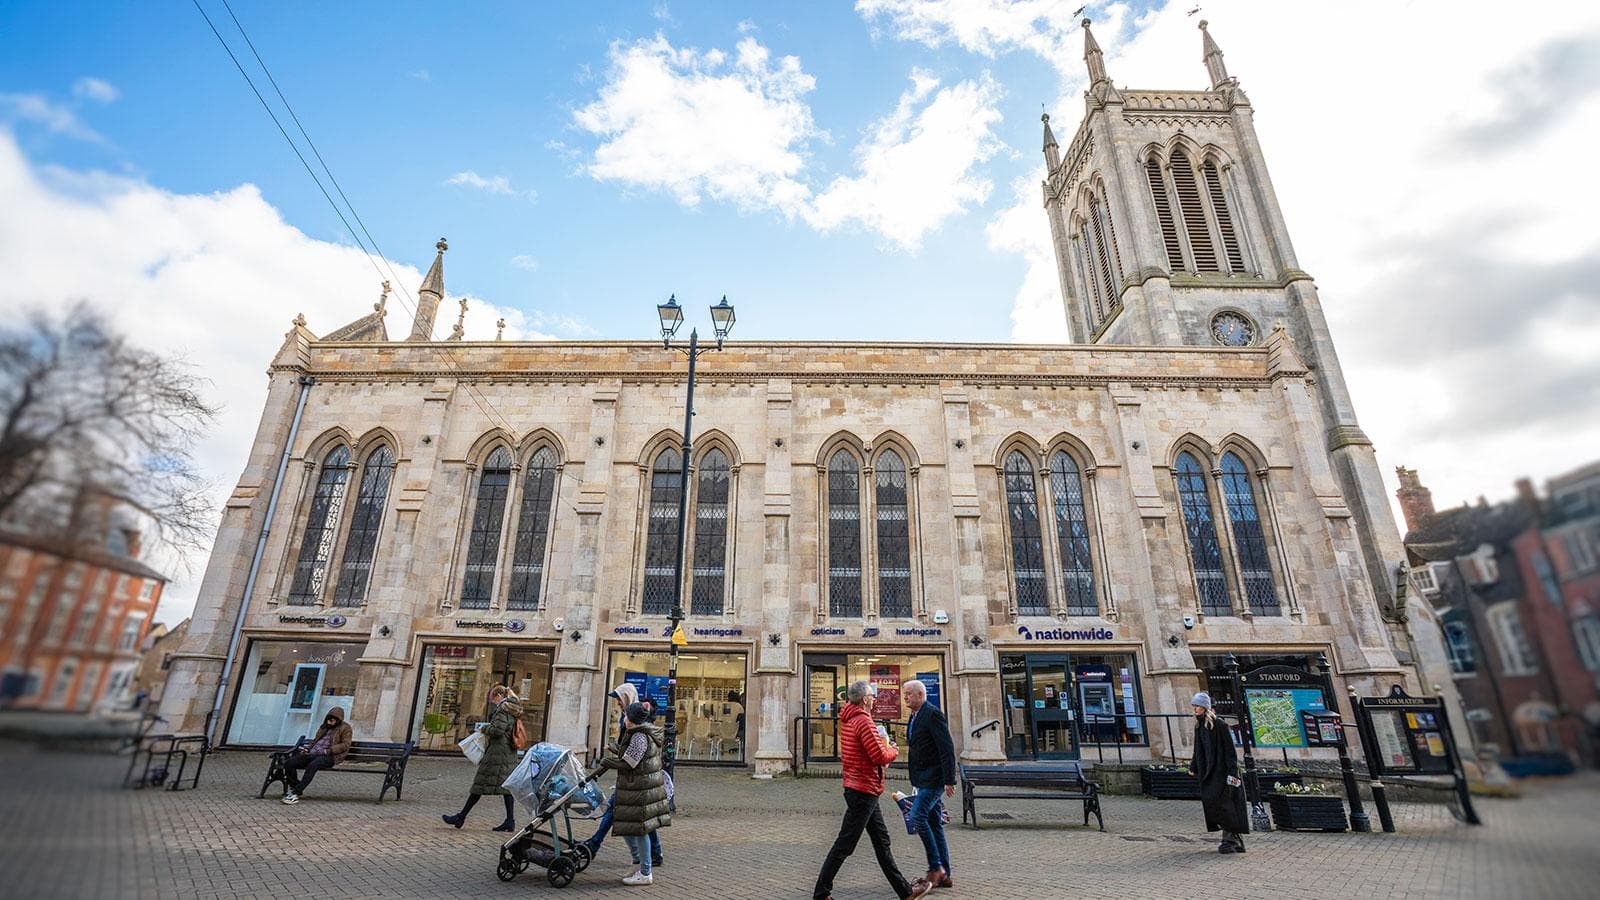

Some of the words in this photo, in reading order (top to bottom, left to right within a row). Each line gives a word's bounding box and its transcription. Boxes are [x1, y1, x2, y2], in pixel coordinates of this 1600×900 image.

[614, 626, 649, 636] opticians
[694, 627, 743, 637] hearingcare
[810, 627, 846, 636] opticians
[895, 627, 942, 637] hearingcare
[1035, 627, 1114, 640] nationwide
[1259, 673, 1301, 681] STAMFORD
